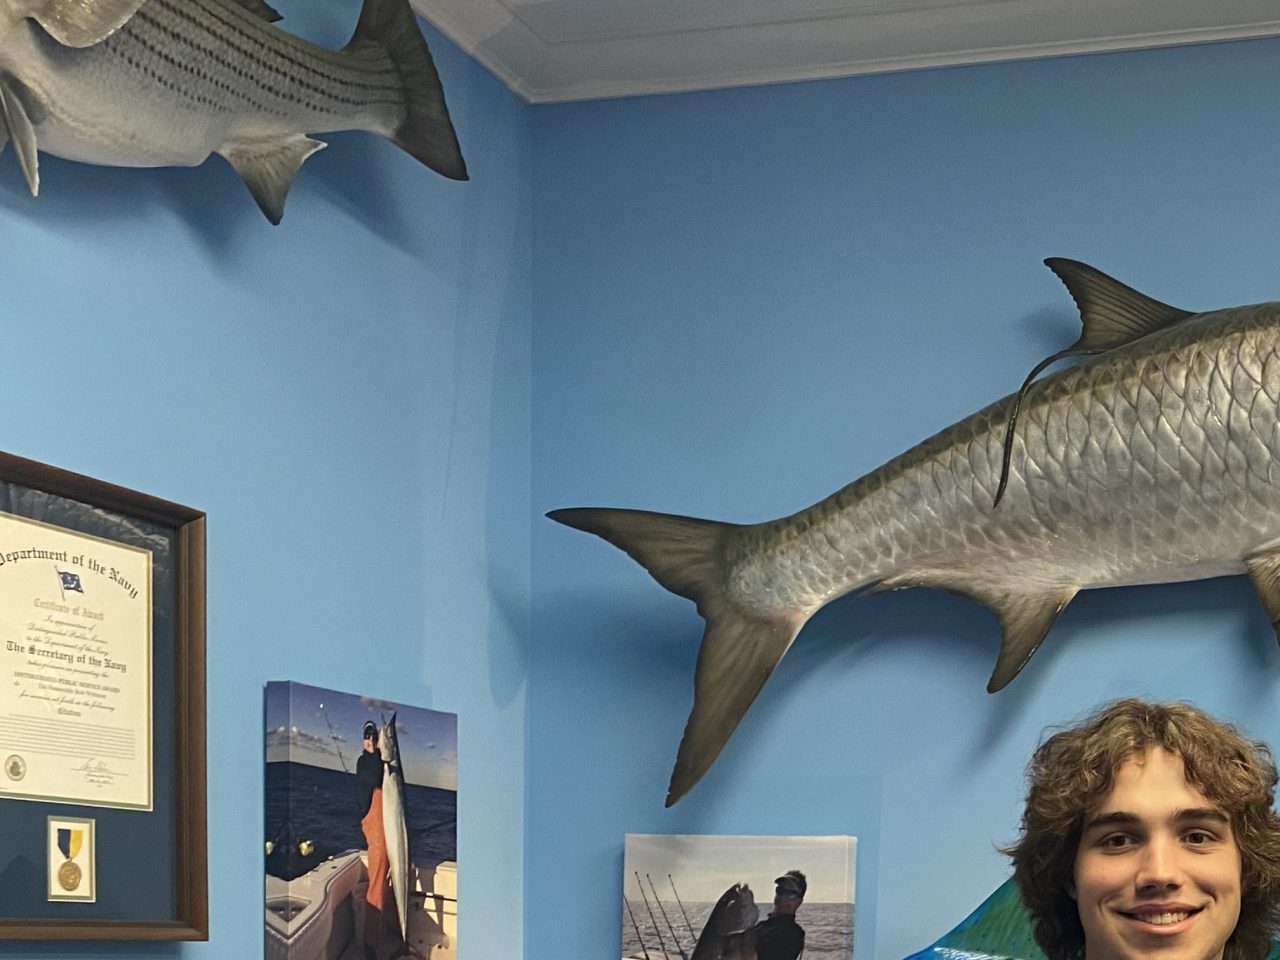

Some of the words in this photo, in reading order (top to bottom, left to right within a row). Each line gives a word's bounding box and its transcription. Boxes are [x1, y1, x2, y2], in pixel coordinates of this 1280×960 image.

[72, 555, 84, 566] of
[89, 558, 106, 574] the
[109, 567, 138, 599] Navy
[6, 640, 25, 653] The
[28, 644, 74, 664] Secretary
[76, 654, 86, 664] of
[89, 655, 102, 667] the
[104, 658, 127, 673] Navy
